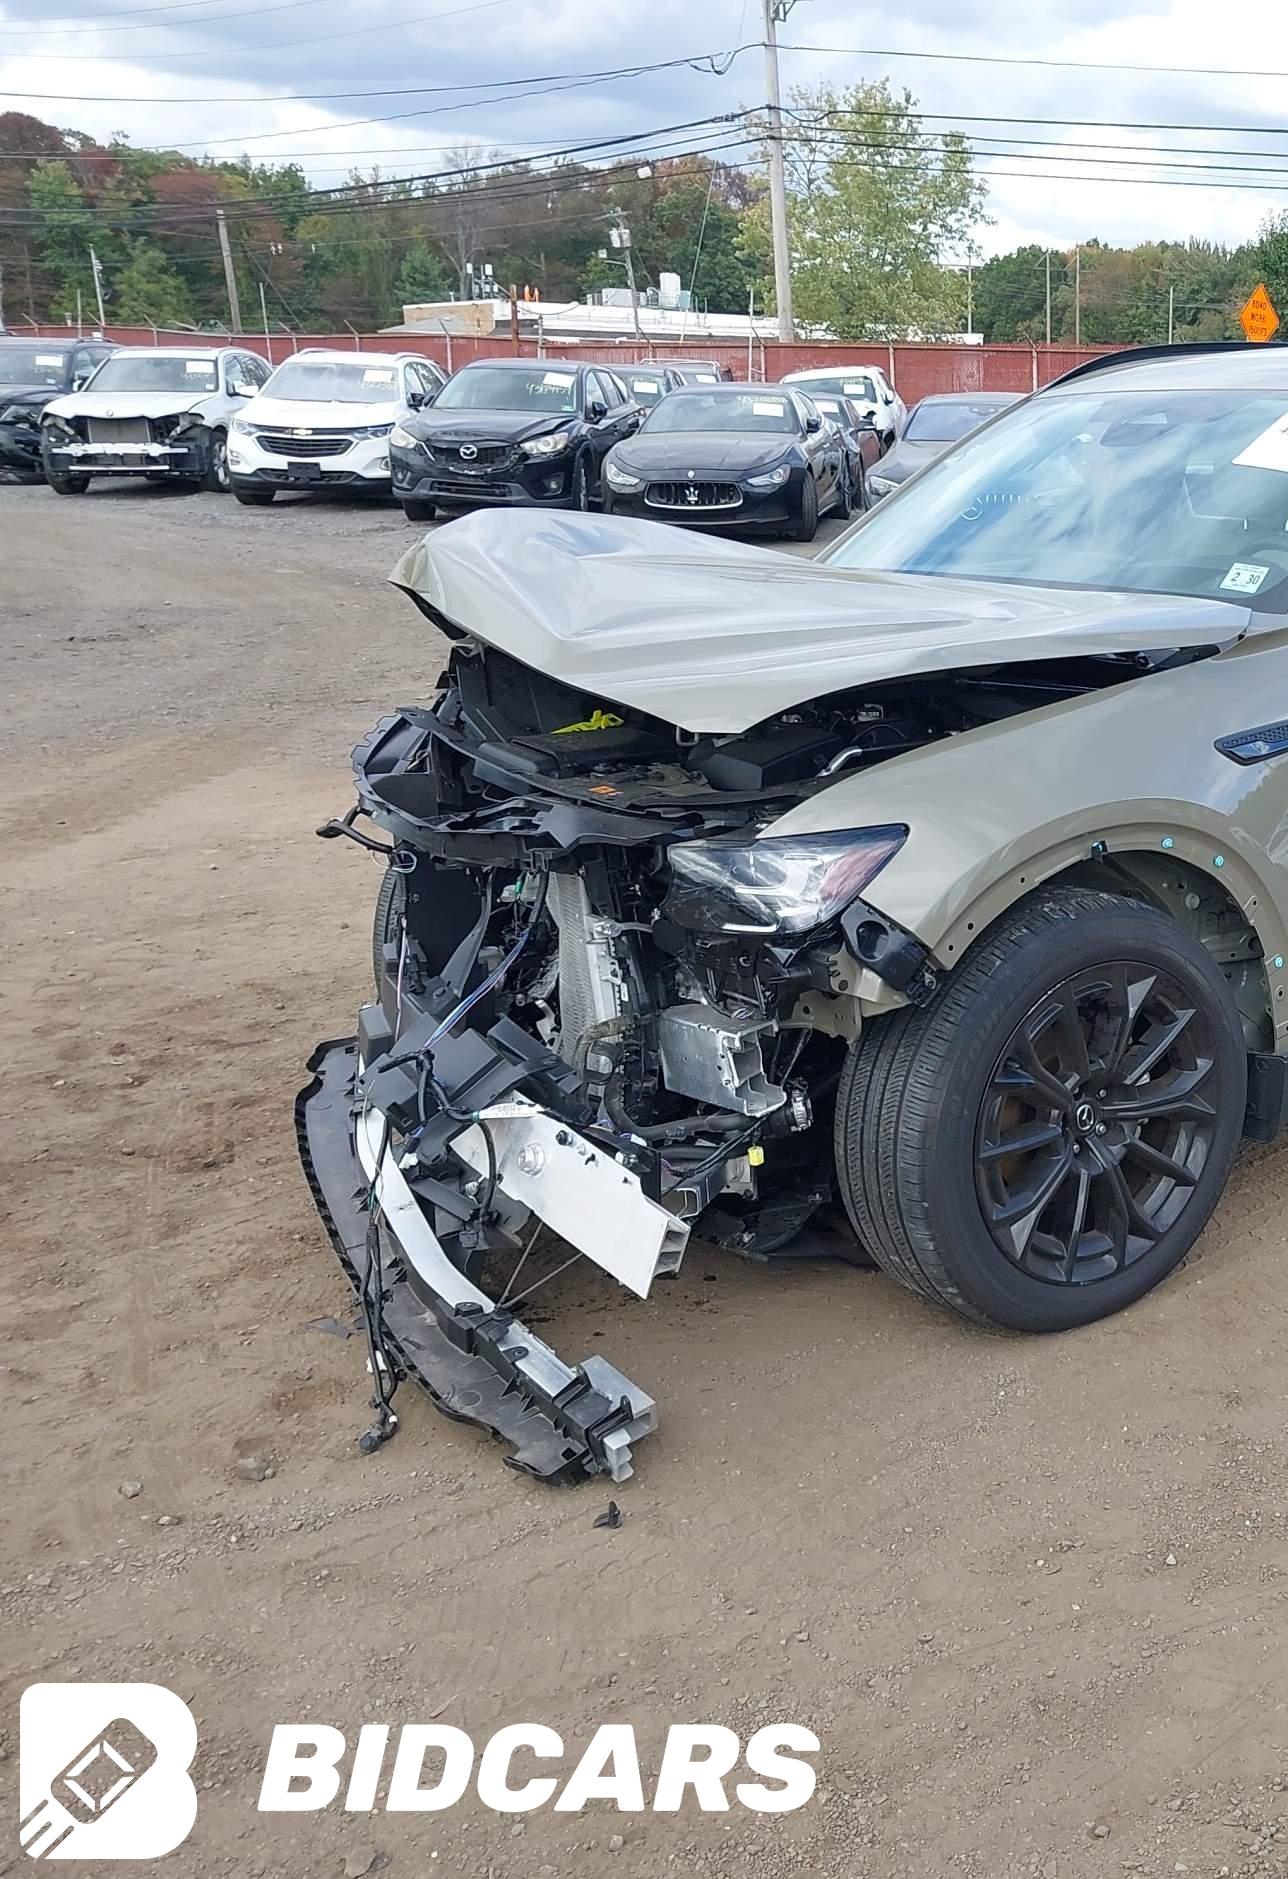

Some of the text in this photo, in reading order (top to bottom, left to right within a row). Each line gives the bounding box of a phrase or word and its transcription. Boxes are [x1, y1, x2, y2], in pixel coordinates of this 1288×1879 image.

[1252, 299, 1267, 310] ROAD
[1250, 312, 1266, 323] WORK
[1231, 571, 1261, 585] 2 30
